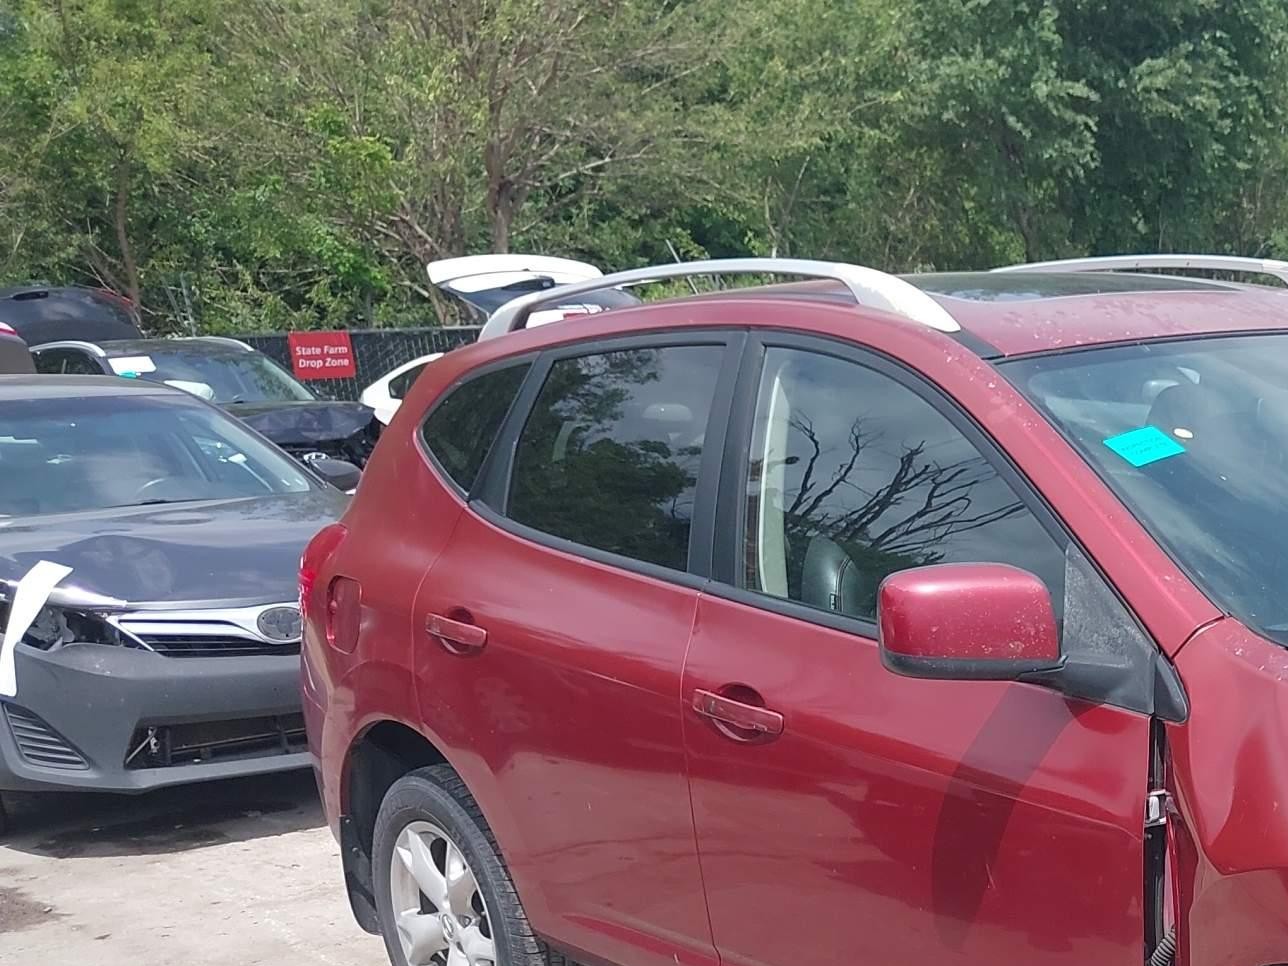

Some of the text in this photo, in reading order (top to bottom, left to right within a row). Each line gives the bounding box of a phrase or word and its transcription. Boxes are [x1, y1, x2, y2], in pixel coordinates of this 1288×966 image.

[296, 345, 348, 355] State Farm
[299, 357, 349, 368] Drop Zone
